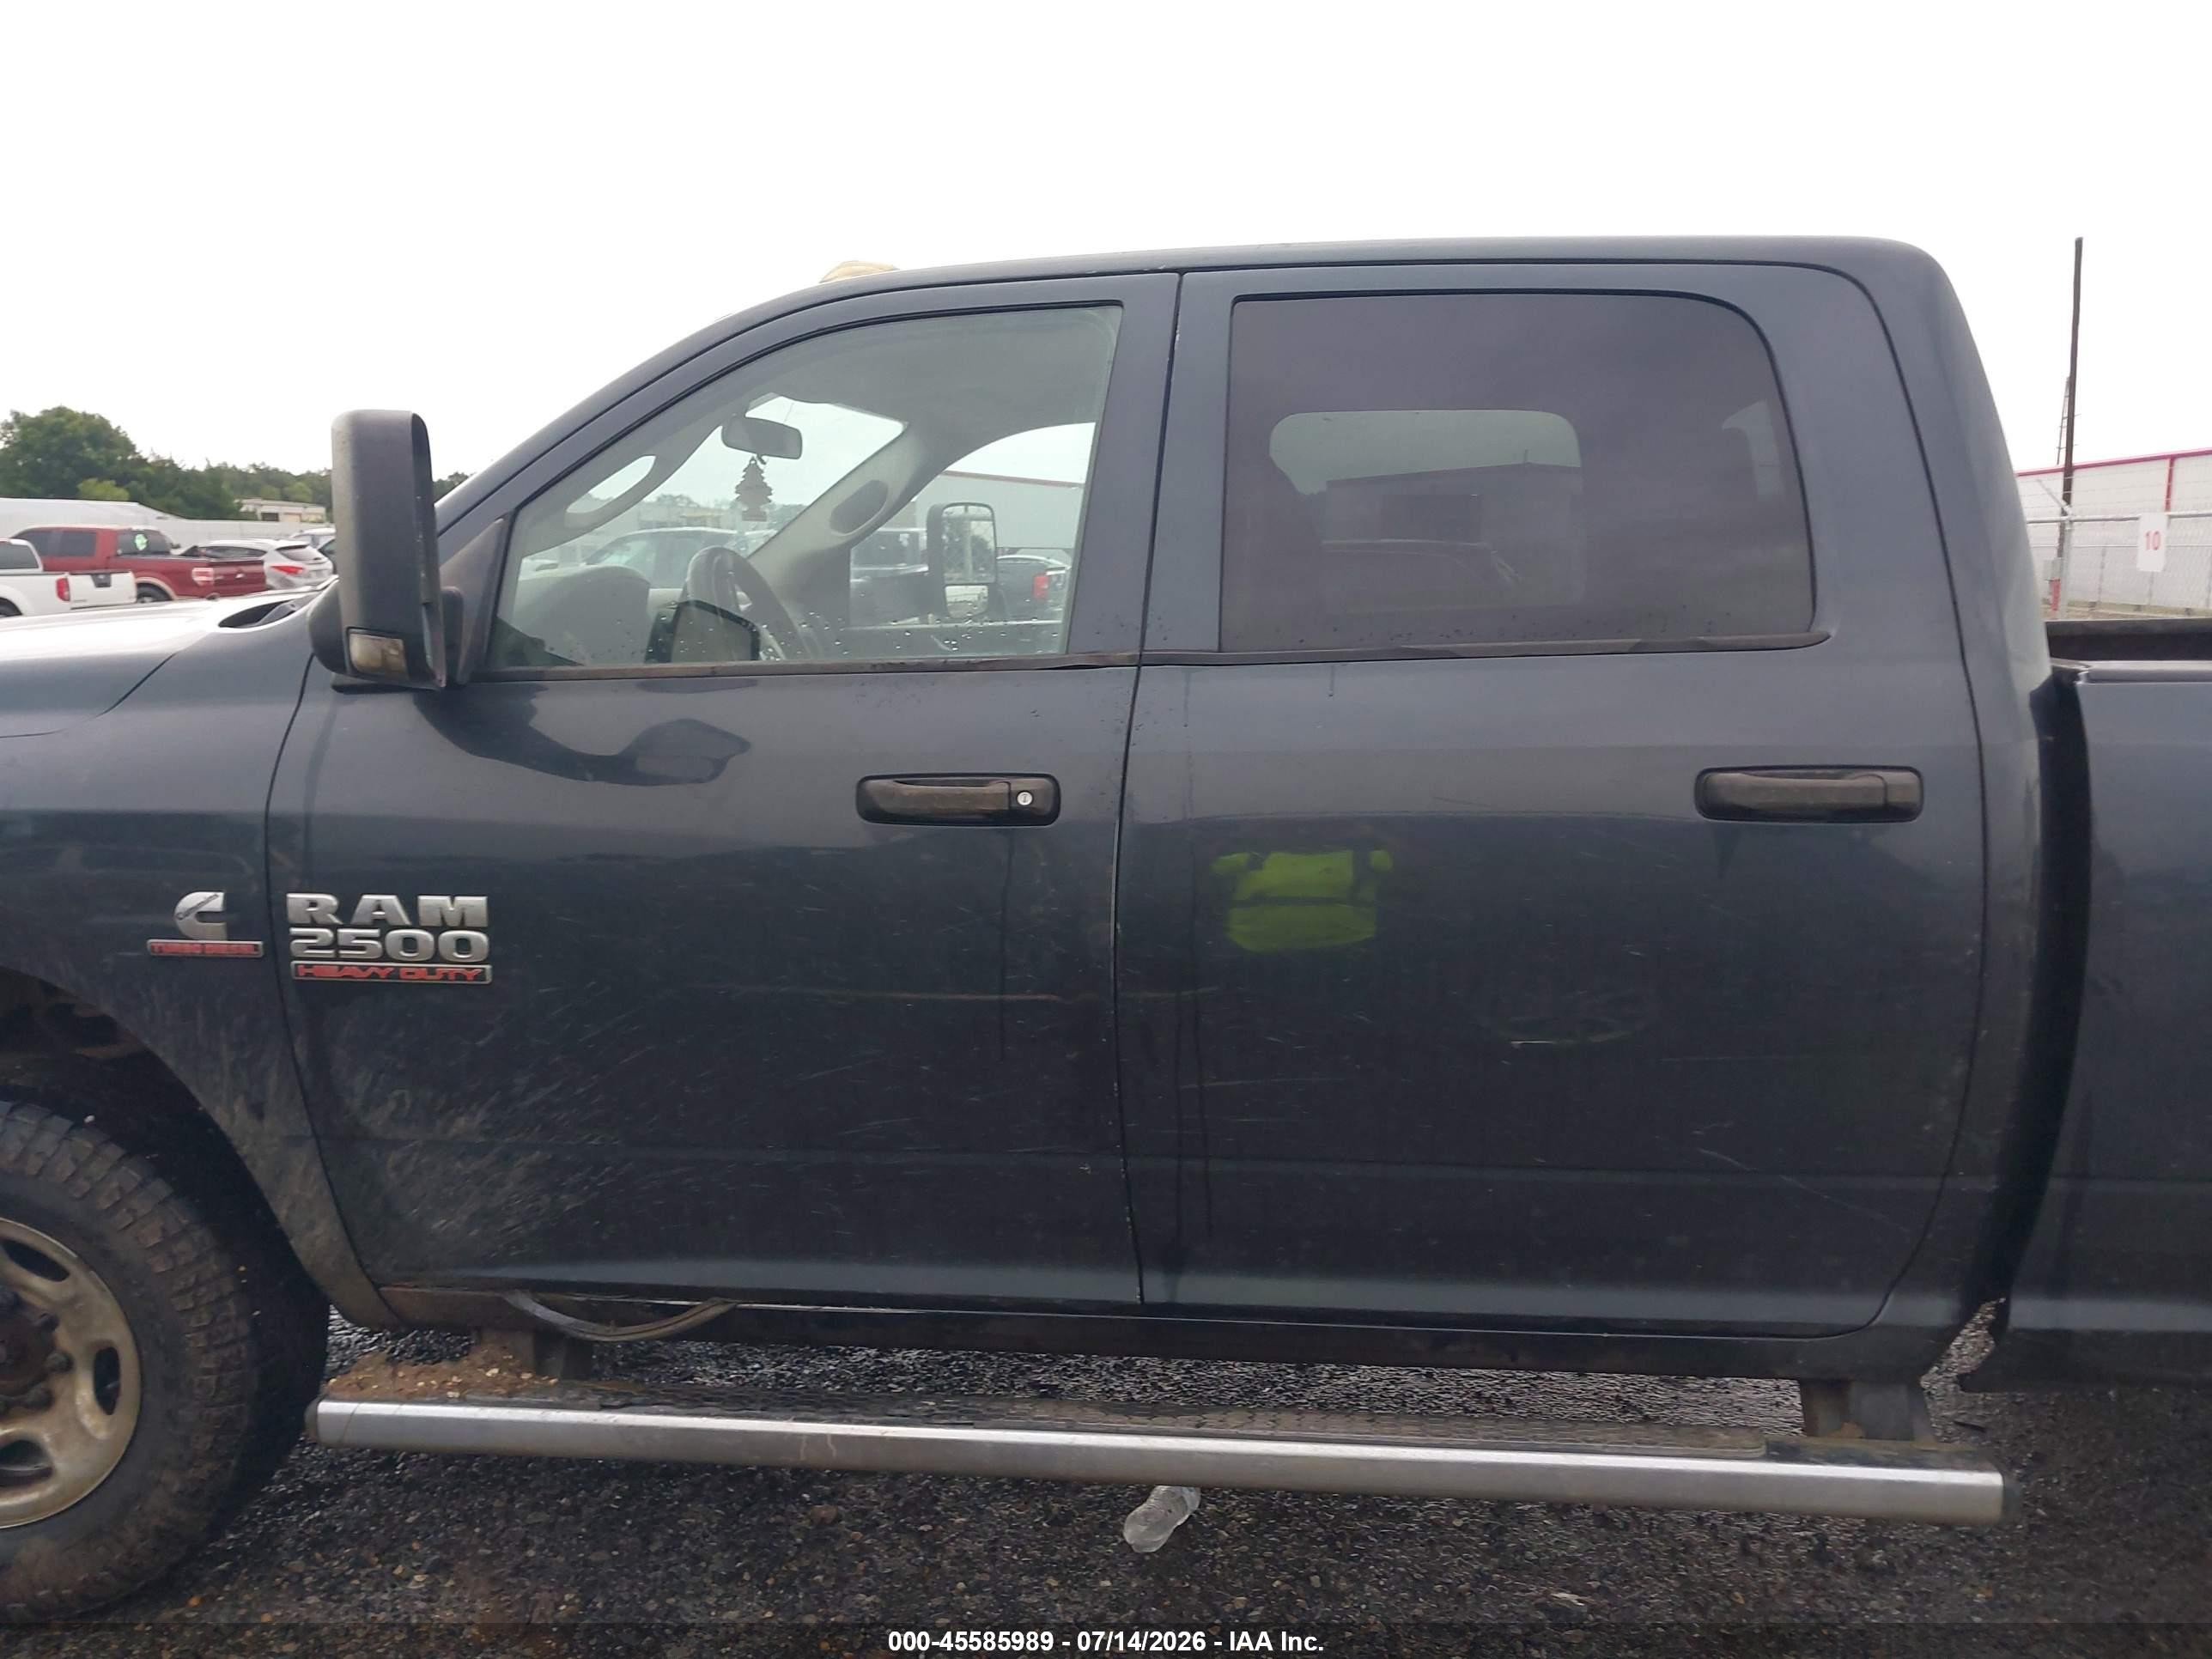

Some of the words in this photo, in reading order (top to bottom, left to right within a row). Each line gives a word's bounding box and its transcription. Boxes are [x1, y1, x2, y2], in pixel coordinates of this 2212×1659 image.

[2145, 530, 2161, 551] 10
[286, 893, 489, 927] RAM
[289, 927, 490, 962] 2500
[297, 964, 398, 980] HEAVY
[399, 966, 483, 981] DUTY
